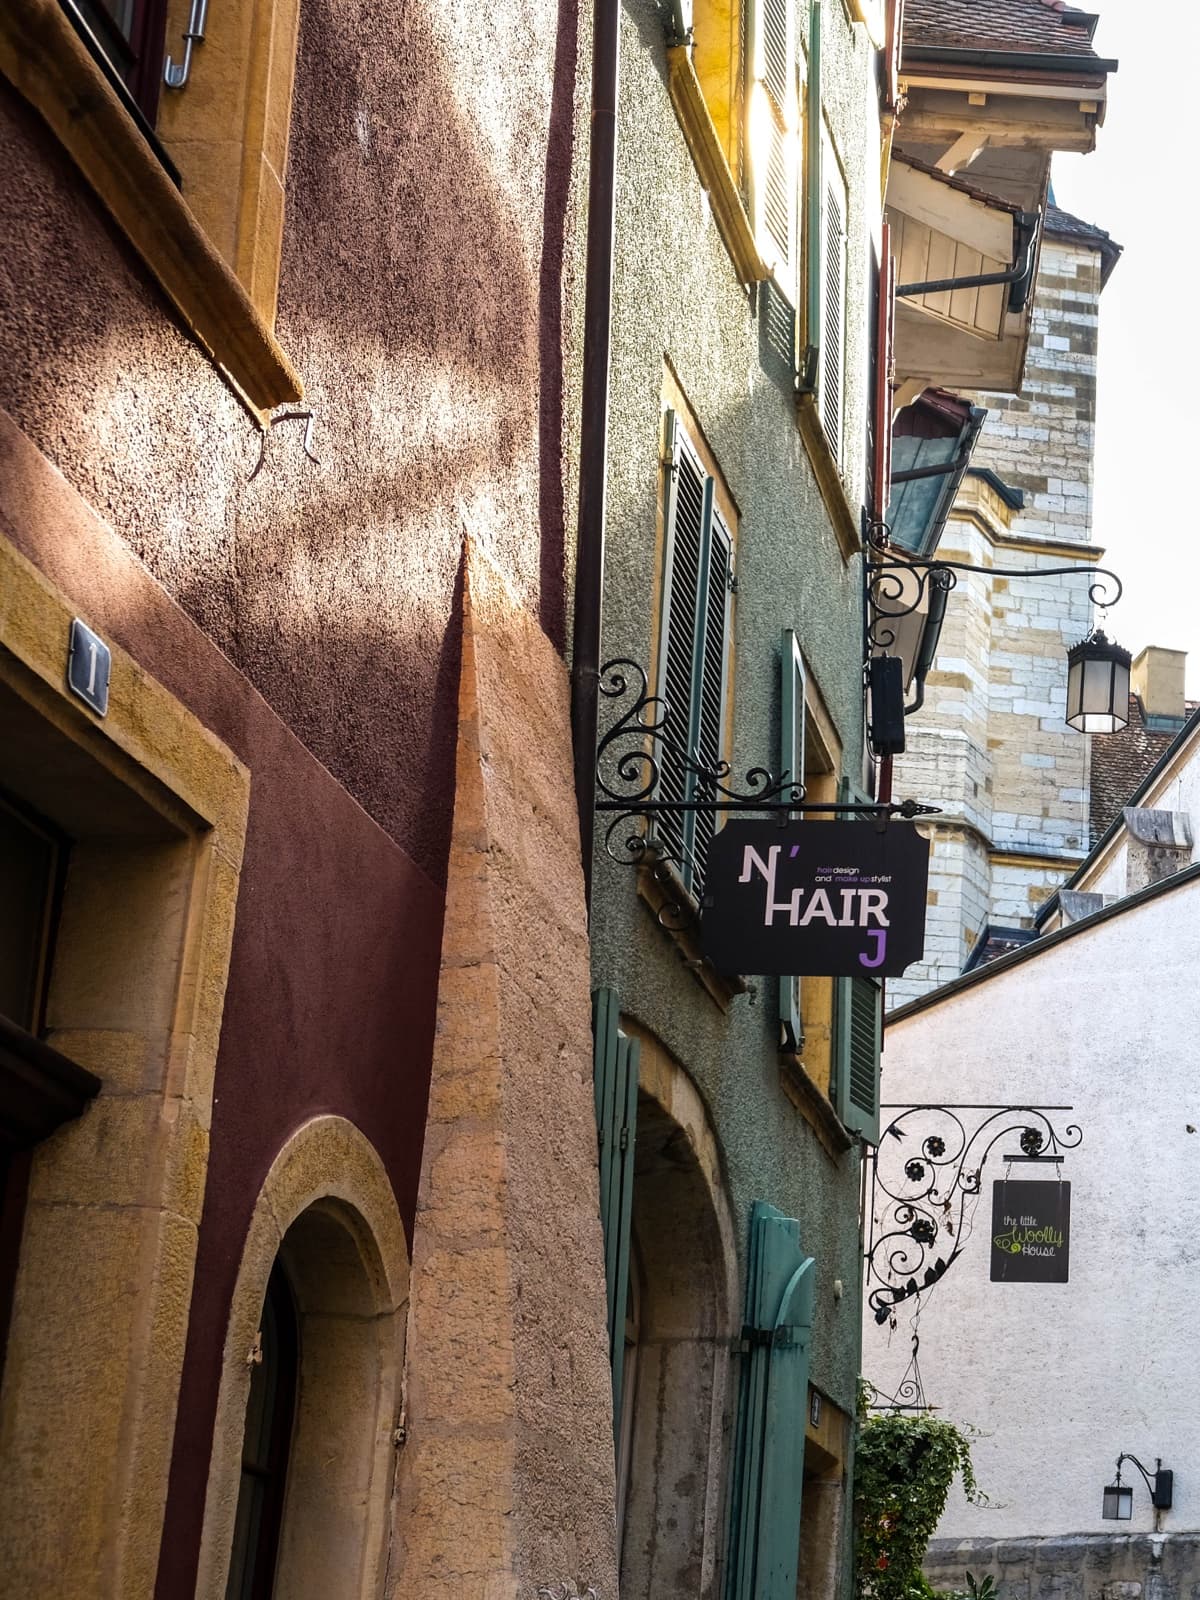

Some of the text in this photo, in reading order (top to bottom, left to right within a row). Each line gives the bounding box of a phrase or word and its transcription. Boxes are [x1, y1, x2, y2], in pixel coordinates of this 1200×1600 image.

[86, 642, 97, 696] 1
[858, 929, 887, 968] J
[1003, 1215, 1038, 1226] the little
[1022, 1244, 1056, 1257] House
